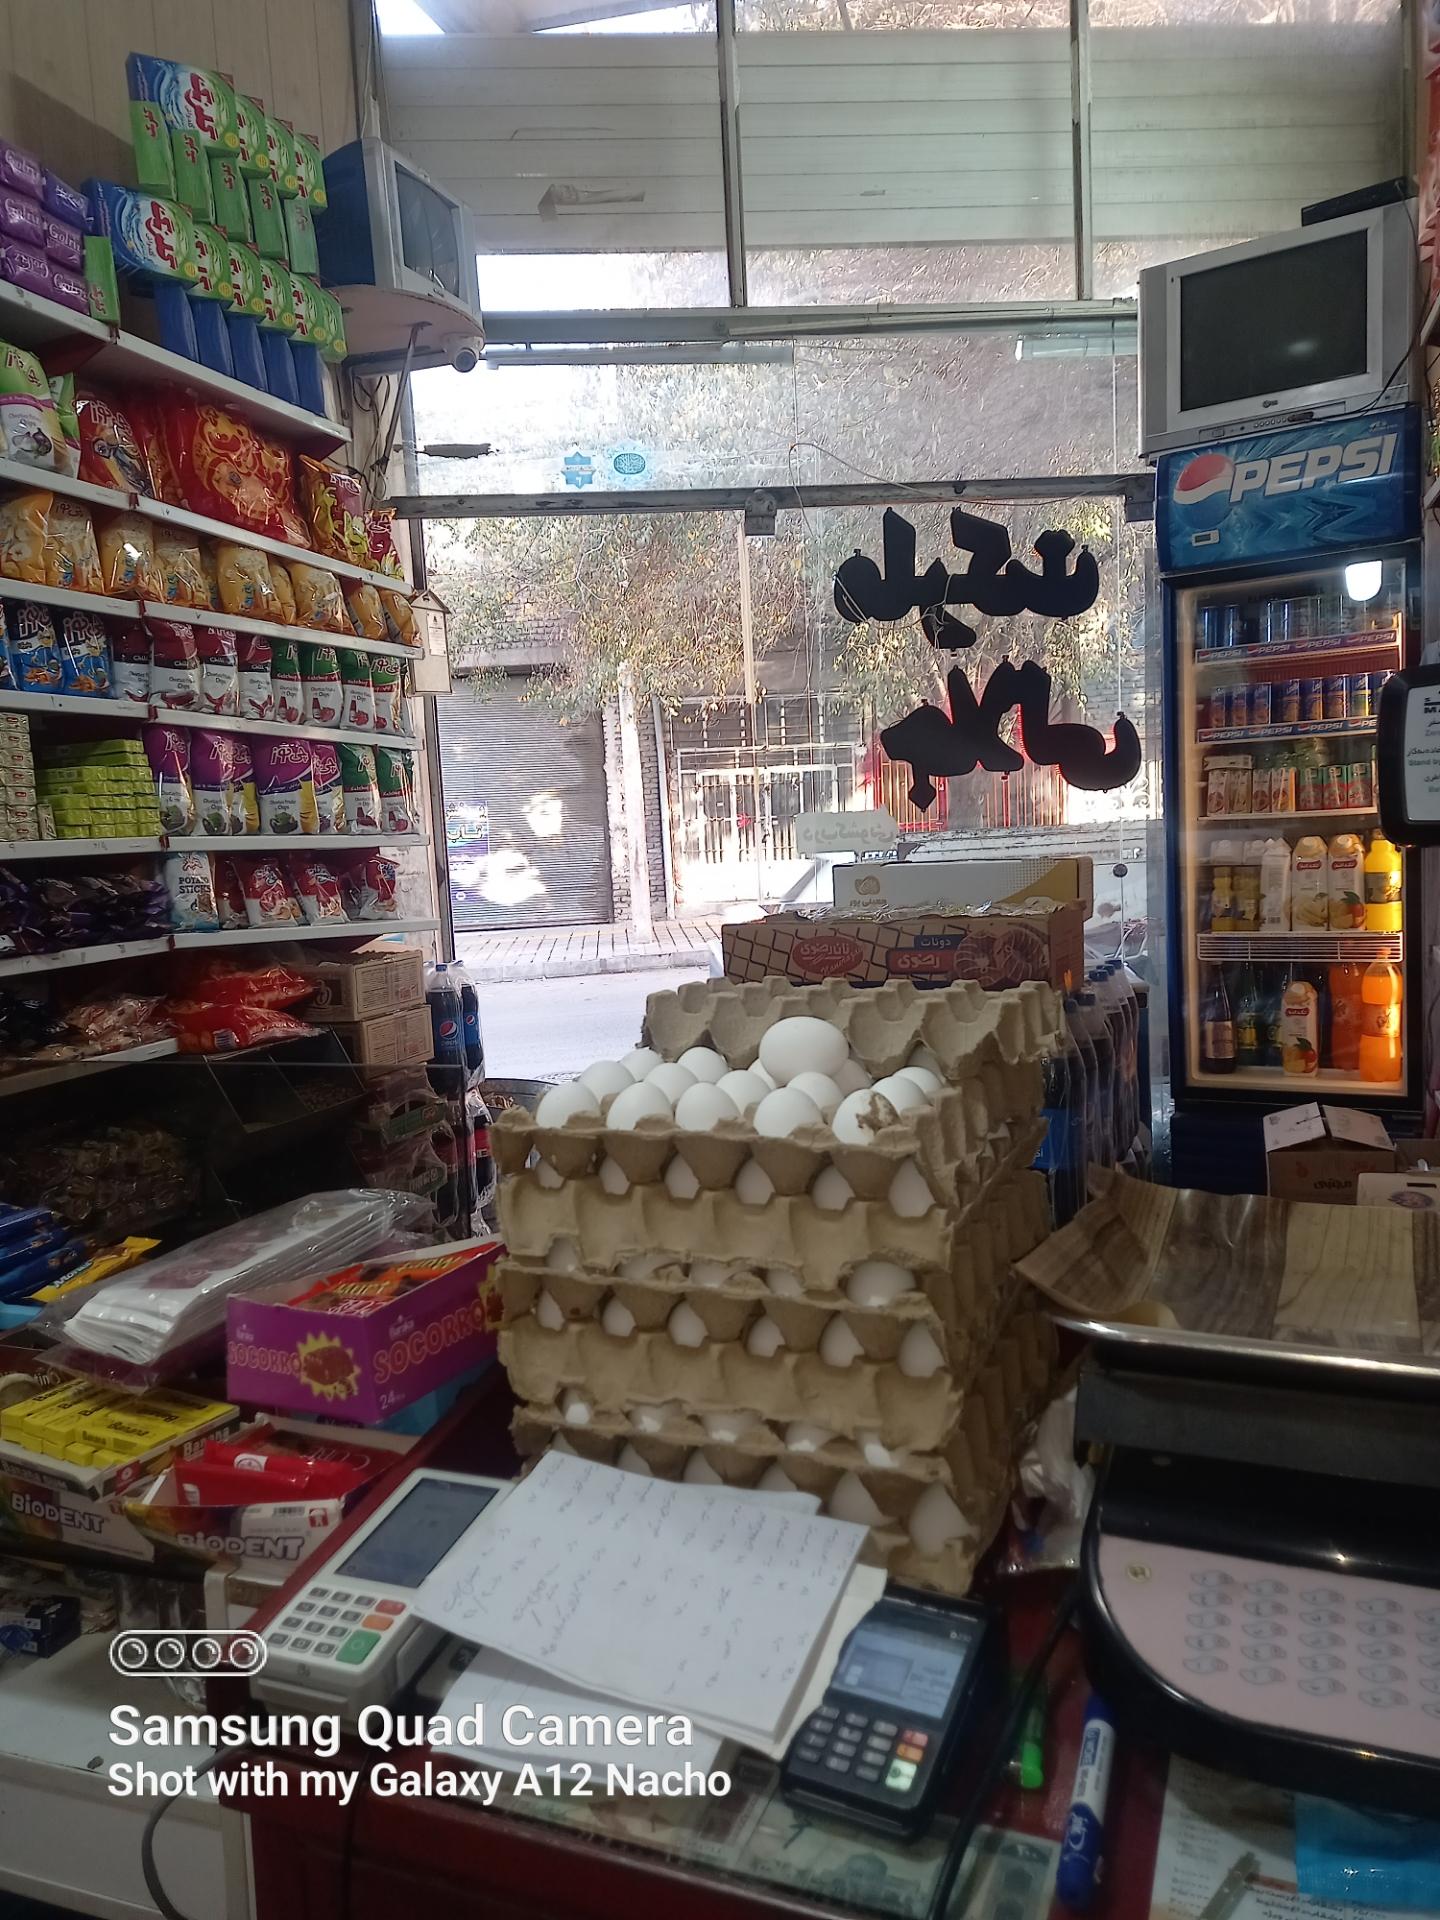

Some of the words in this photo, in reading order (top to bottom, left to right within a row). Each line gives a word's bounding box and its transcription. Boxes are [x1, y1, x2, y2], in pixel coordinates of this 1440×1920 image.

[1229, 433, 1398, 503] PEPSI
[1307, 638, 1341, 649] PEPSI
[1360, 633, 1395, 644] PEPSI
[1258, 643, 1291, 654] PEPSI
[1259, 727, 1292, 737] PEPSI
[1310, 722, 1343, 732] PEPSI
[179, 885, 211, 894] STICKS
[921, 936, 952, 949] دونات
[897, 951, 940, 969] رضوی
[374, 1299, 485, 1384] SOCORRO
[228, 1340, 302, 1377] SOCORRO
[380, 1391, 396, 1410] 24
